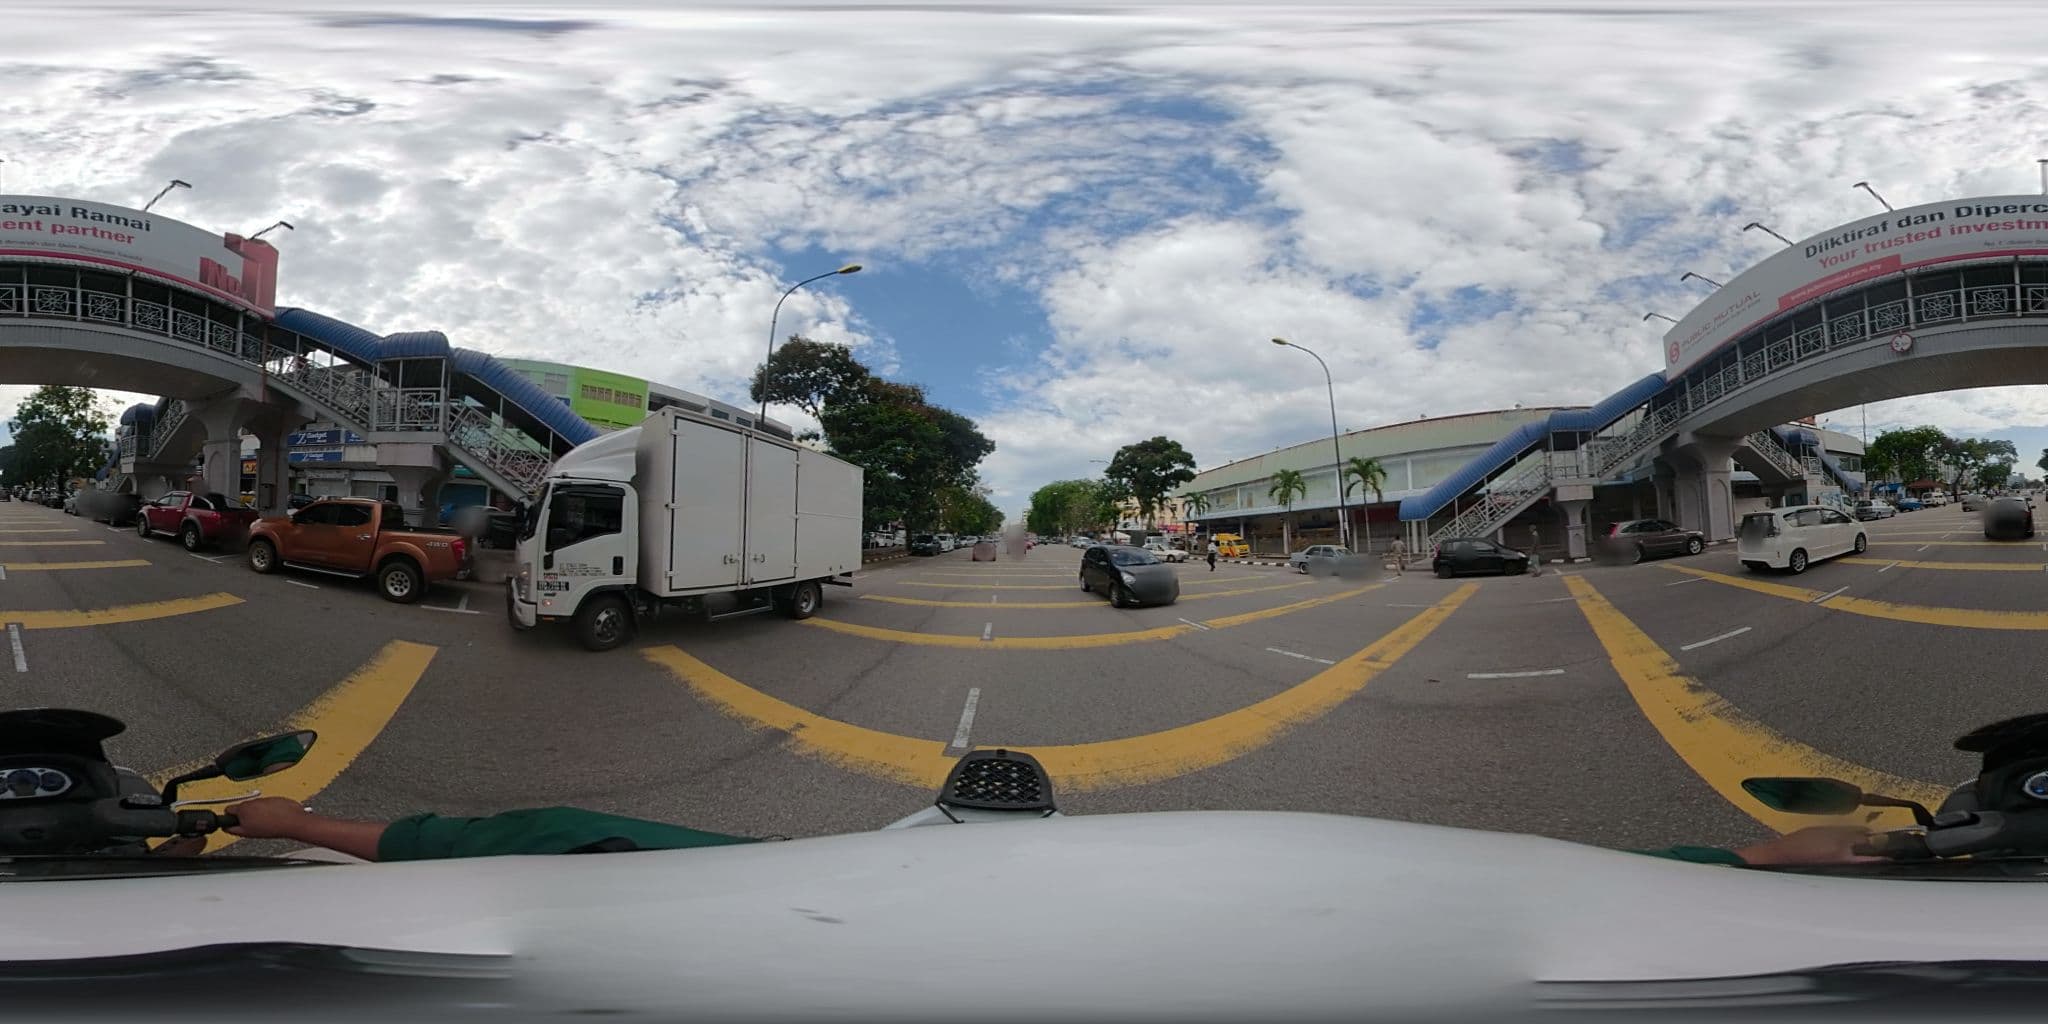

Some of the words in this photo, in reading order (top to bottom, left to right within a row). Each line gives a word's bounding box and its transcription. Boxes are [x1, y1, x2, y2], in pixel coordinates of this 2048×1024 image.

[51, 223, 135, 244] partner
[71, 206, 151, 232] Ramai
[1805, 220, 1888, 259] Diiktiraf
[1897, 211, 1945, 229] dan
[1819, 248, 1859, 269] Your
[1863, 227, 1941, 254] trusted
